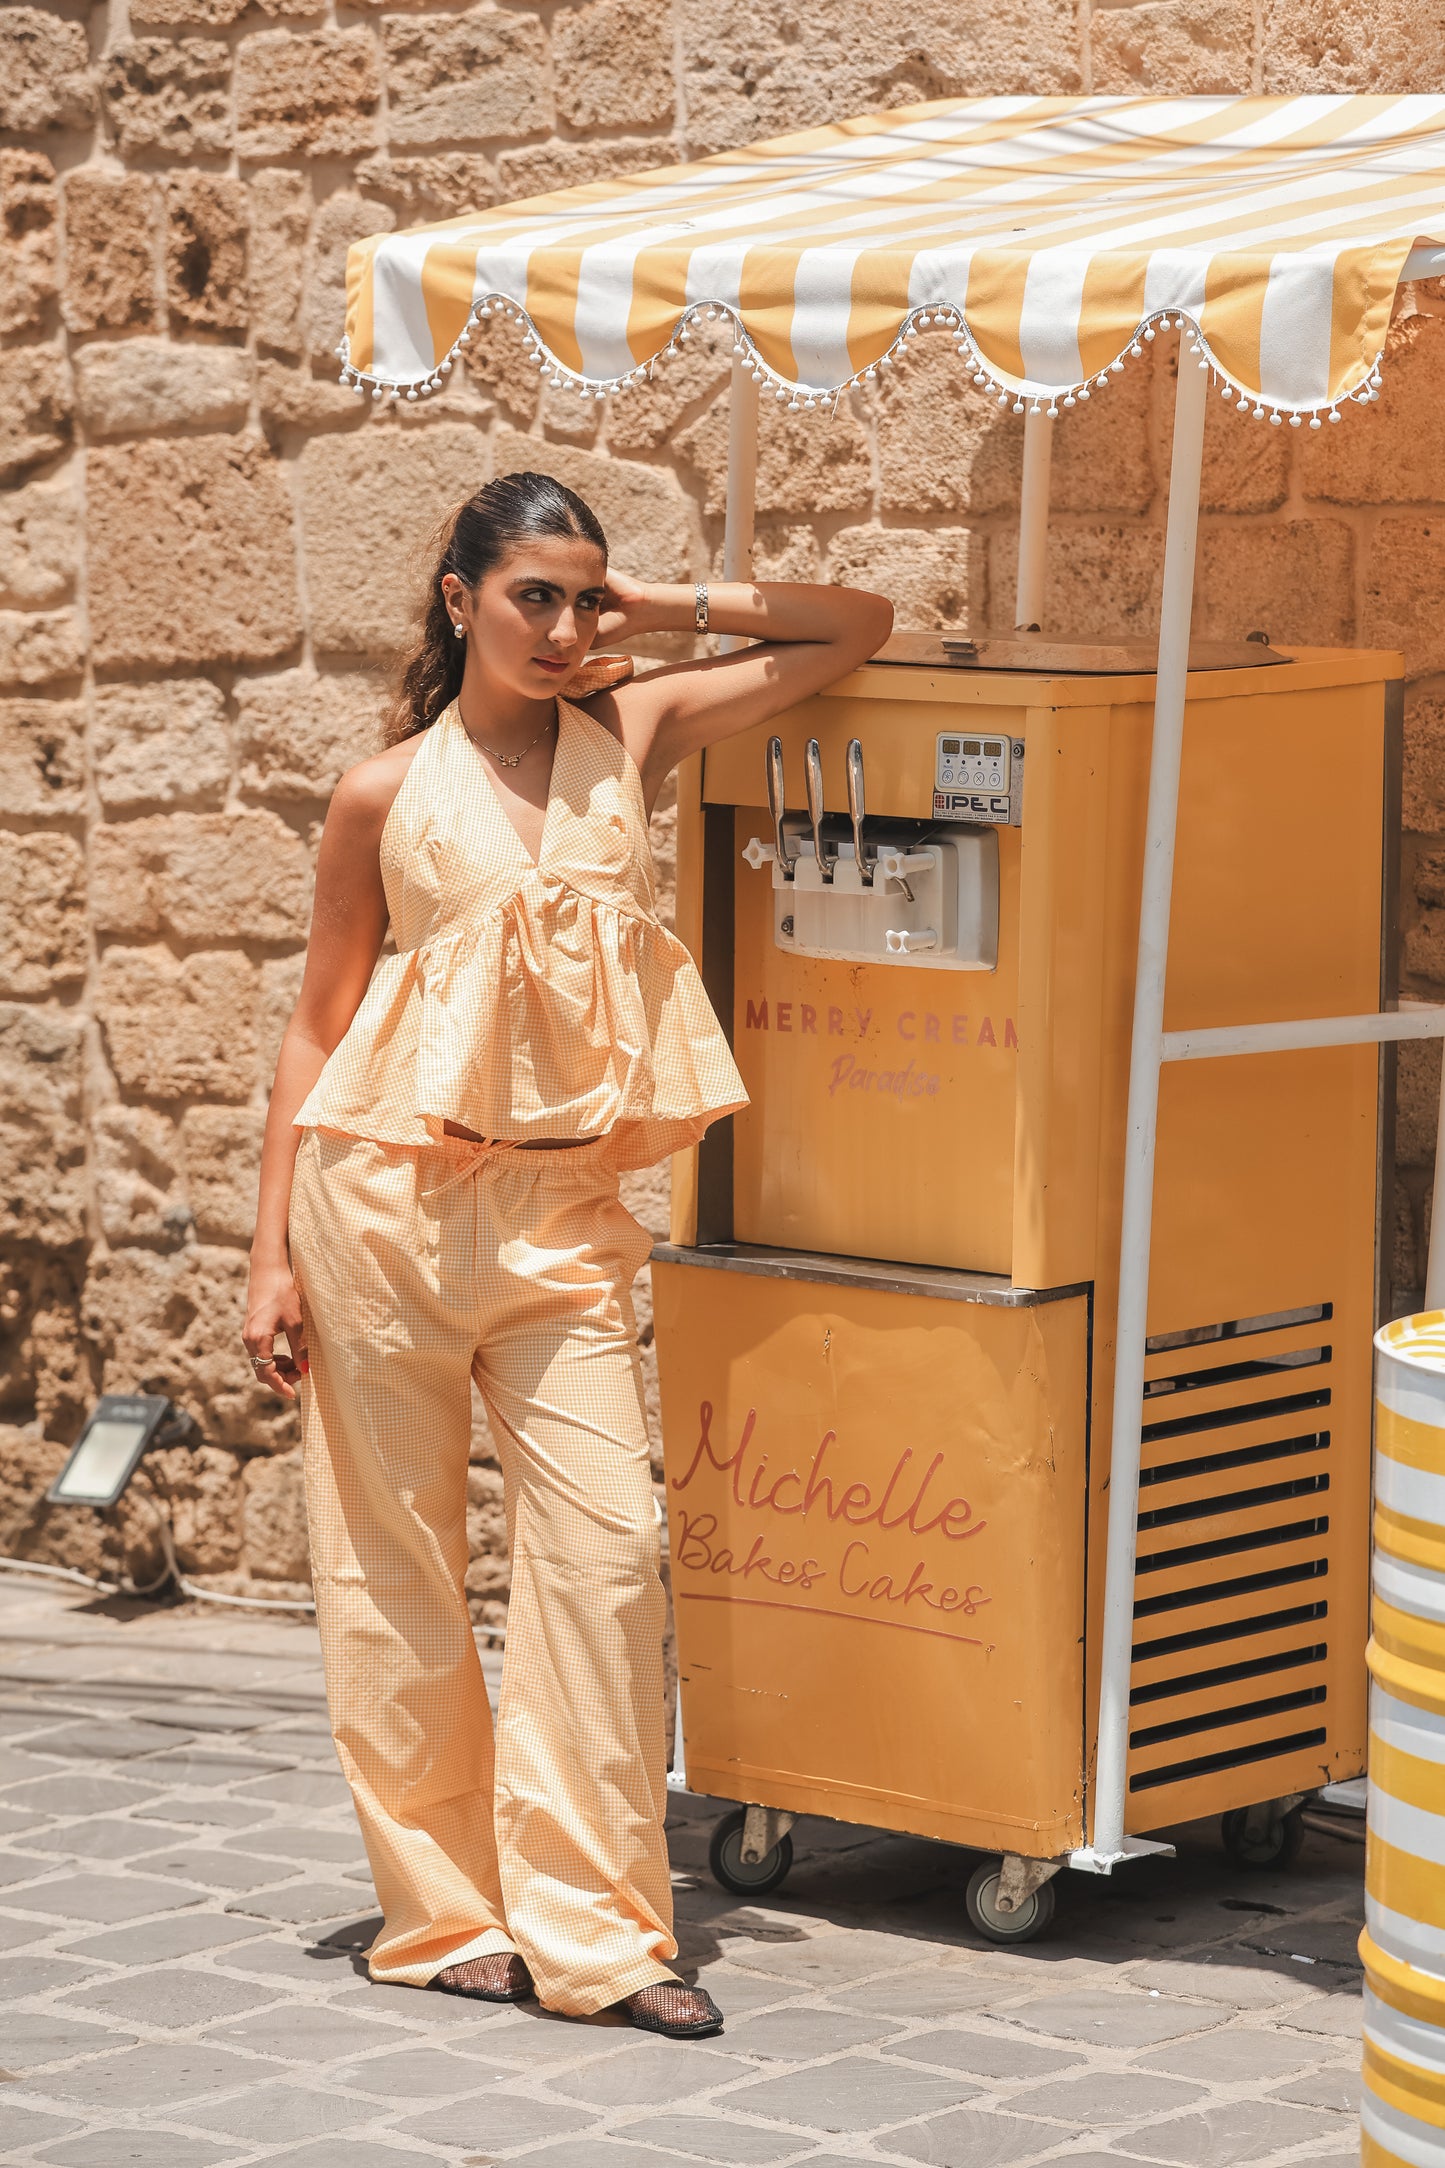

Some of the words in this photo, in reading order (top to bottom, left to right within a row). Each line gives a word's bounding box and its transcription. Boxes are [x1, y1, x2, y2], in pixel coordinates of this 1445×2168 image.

[945, 795, 1008, 814] IPEC
[745, 999, 873, 1038] MERRY
[828, 1053, 942, 1103] Paradise
[671, 1400, 988, 1540] Michelle
[676, 1510, 828, 1589] Bakes
[839, 1540, 994, 1616] Cakes
